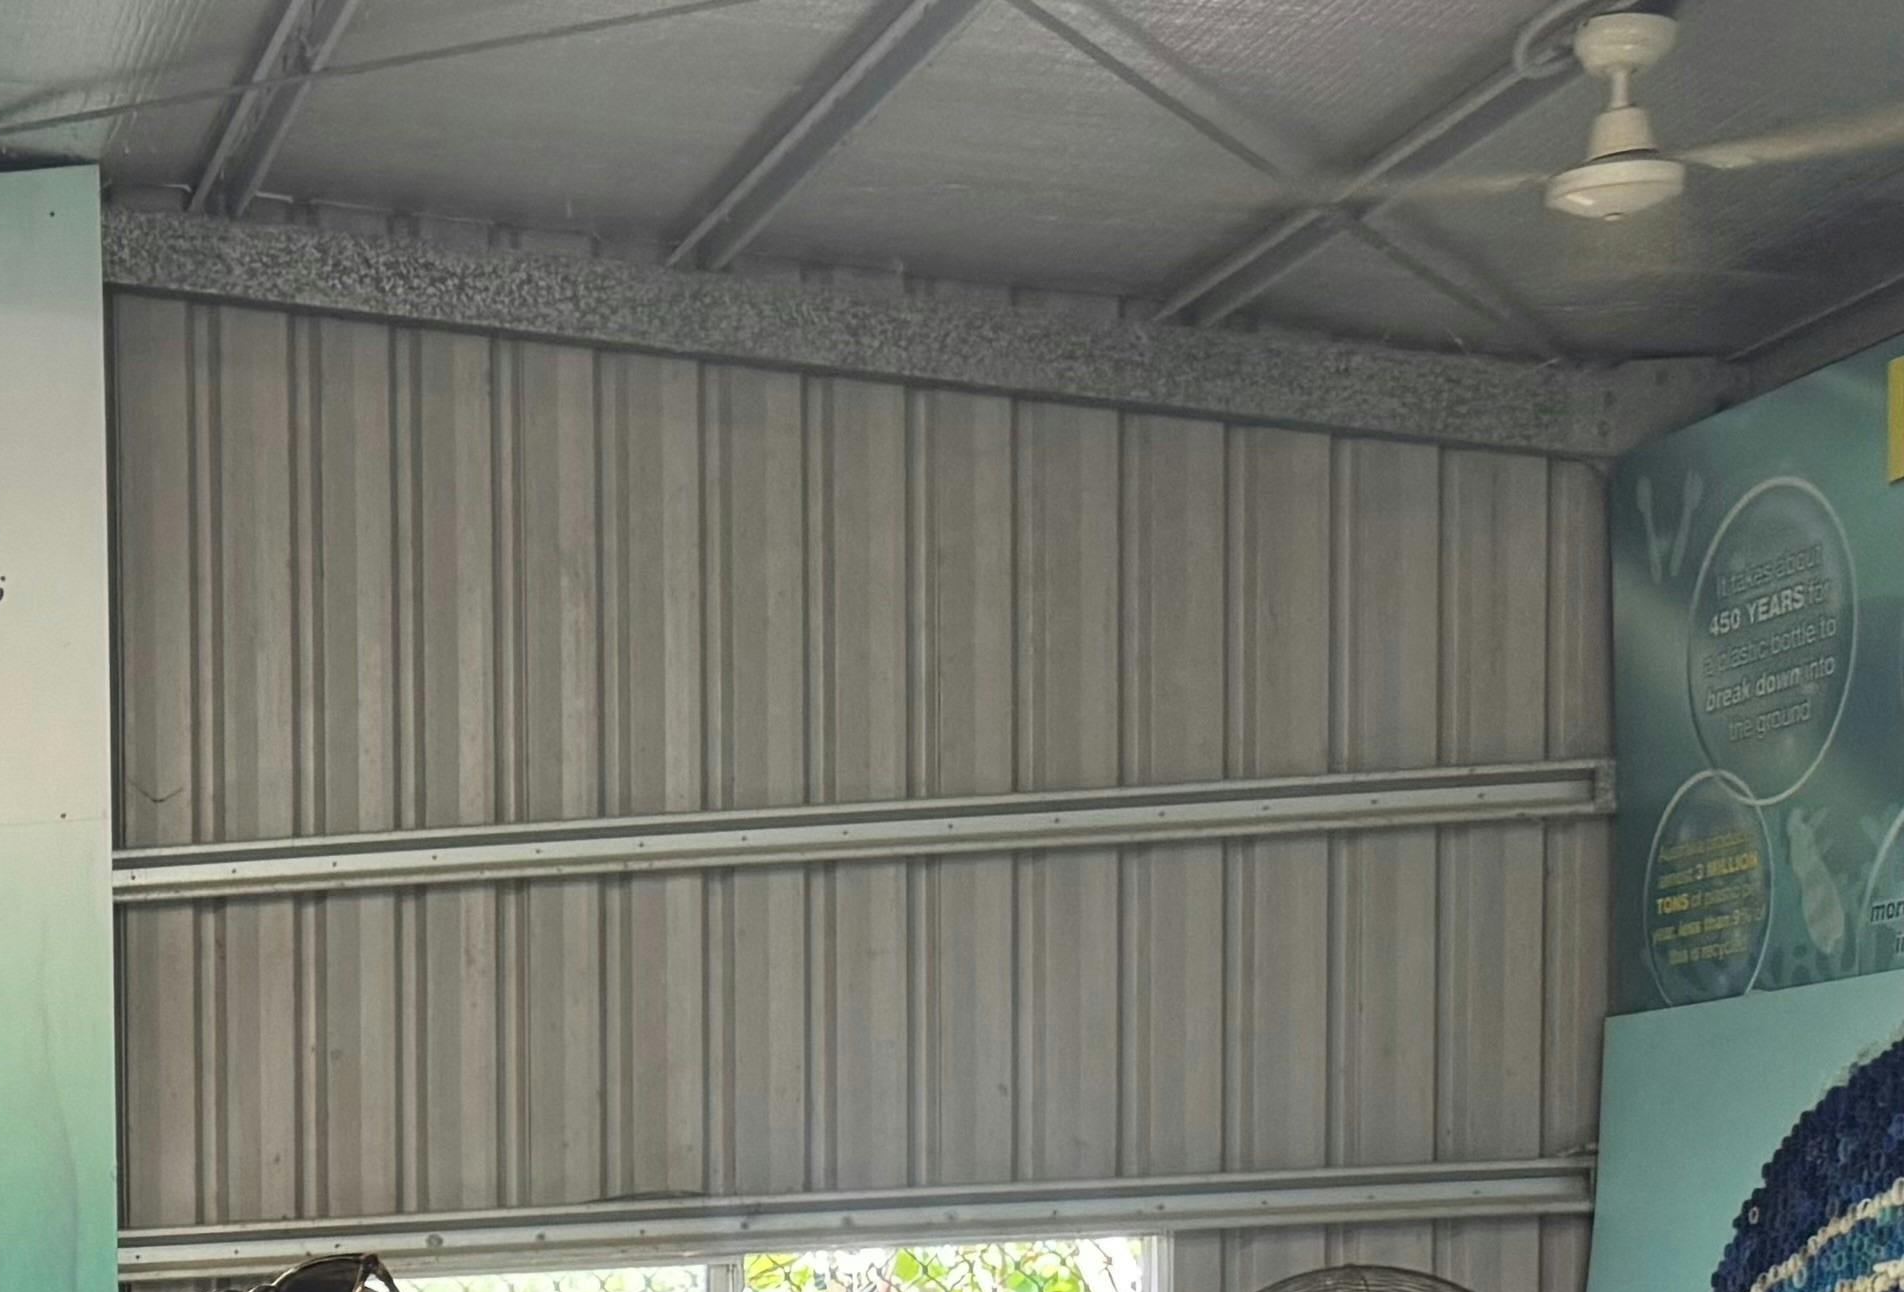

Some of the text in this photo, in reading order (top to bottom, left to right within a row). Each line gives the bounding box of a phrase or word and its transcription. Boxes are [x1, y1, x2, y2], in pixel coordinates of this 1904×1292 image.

[1708, 607, 1742, 637] 450
[1746, 584, 1805, 625] YEARS
[1820, 616, 1838, 638] to
[1705, 655, 1837, 713] break down into
[1755, 699, 1813, 739] ground
